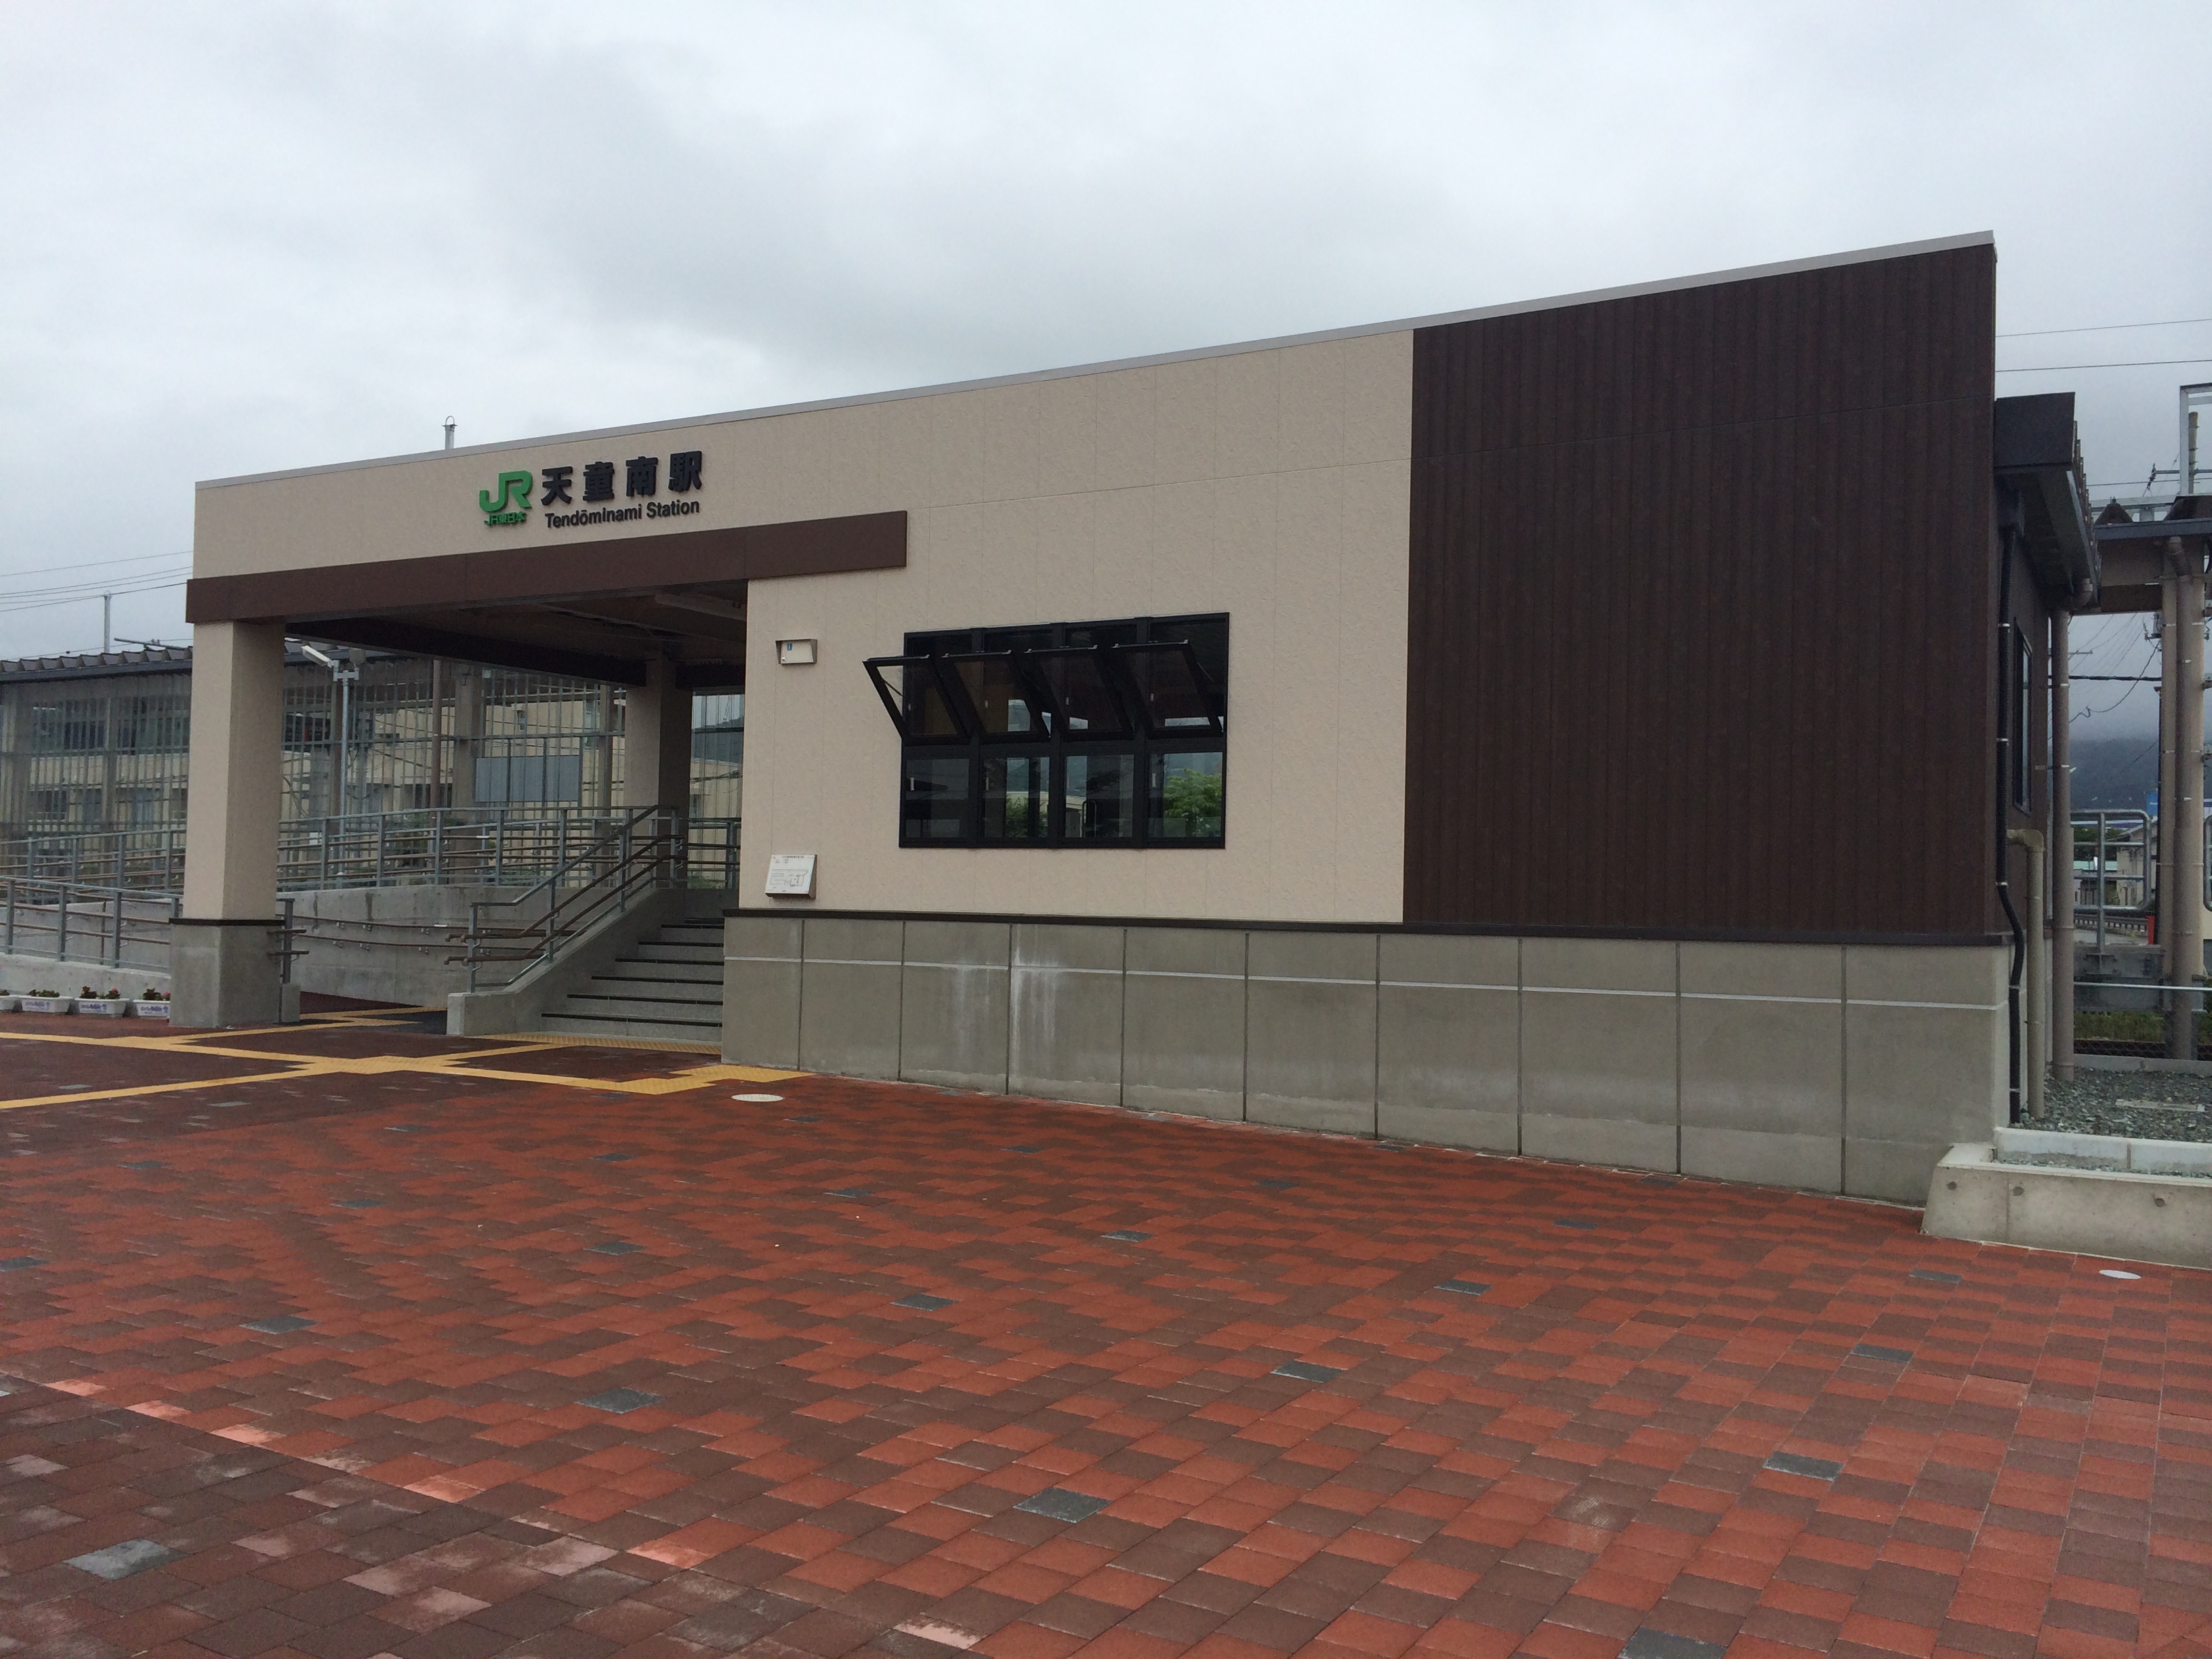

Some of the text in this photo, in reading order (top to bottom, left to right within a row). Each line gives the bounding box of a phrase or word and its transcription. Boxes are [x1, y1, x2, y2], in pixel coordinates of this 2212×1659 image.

[479, 470, 533, 512] JR
[541, 451, 702, 506] 天童南駅
[545, 499, 700, 528] Tendōminami Station
